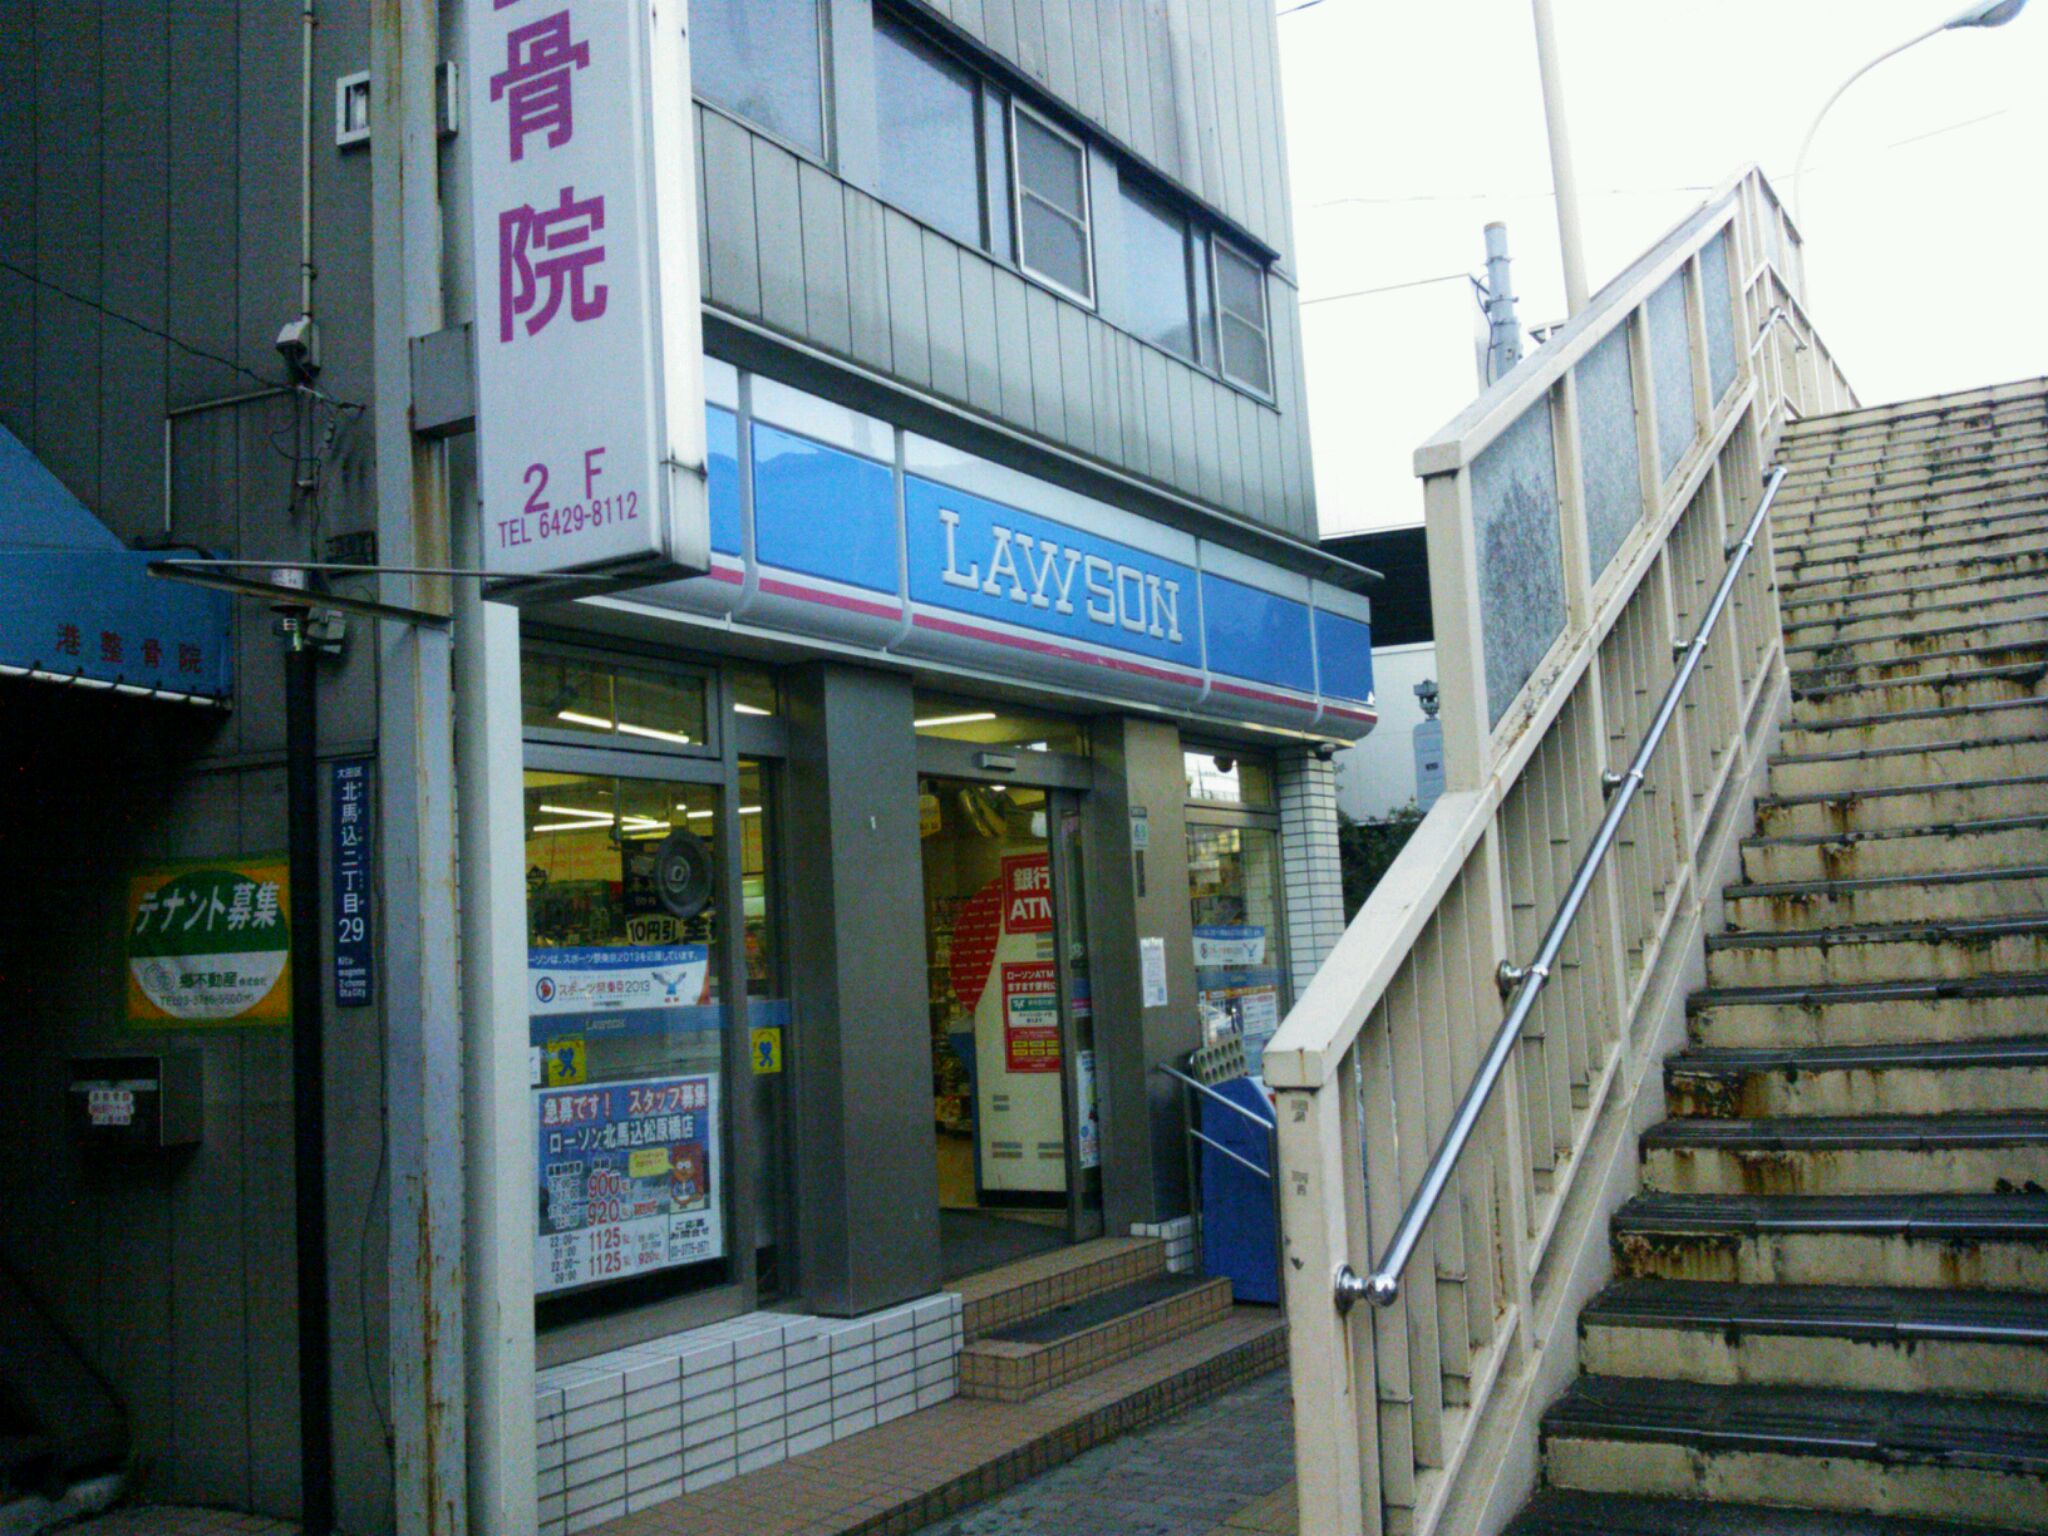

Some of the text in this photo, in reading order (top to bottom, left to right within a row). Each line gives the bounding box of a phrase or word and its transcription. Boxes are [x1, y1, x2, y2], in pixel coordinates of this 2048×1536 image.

[488, 0, 608, 343] 骨院
[498, 490, 639, 549] TEL 6429-8112
[938, 508, 1183, 643] LAWSON
[341, 780, 359, 914] 北馬込二丁目
[1013, 865, 1051, 893] 銀行
[135, 880, 281, 936] テナント募集
[337, 917, 365, 944] 29
[1010, 897, 1053, 922] ATM
[628, 1082, 707, 1115] スタッフ募集
